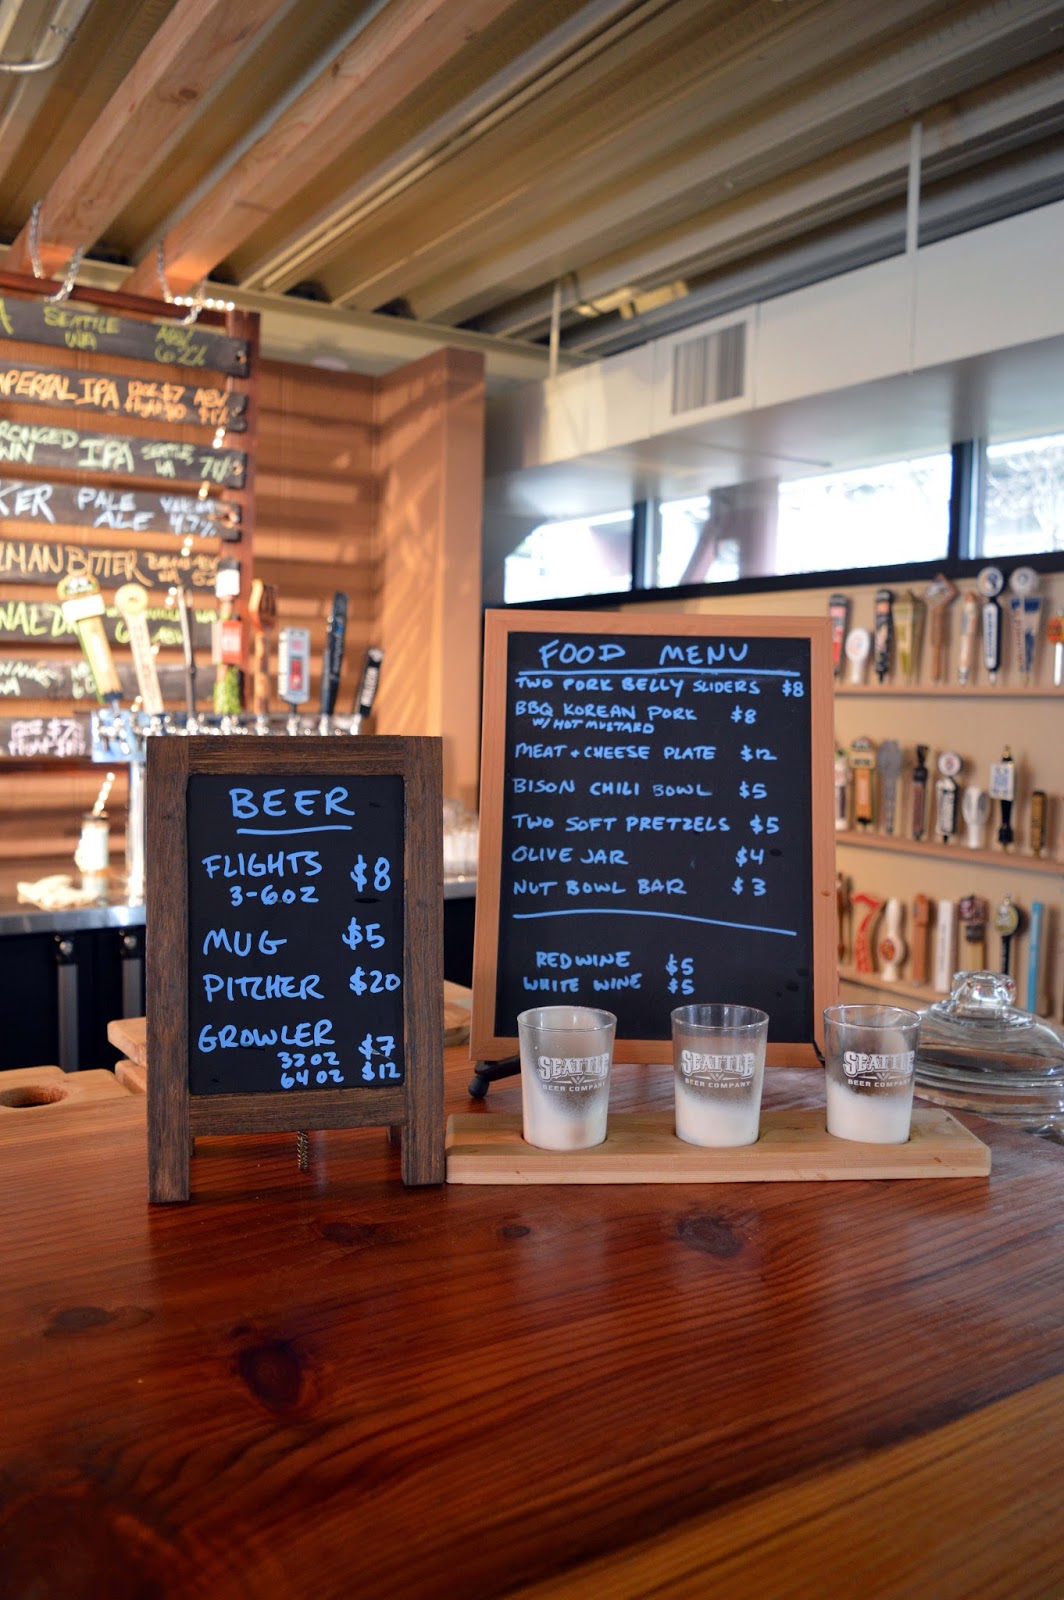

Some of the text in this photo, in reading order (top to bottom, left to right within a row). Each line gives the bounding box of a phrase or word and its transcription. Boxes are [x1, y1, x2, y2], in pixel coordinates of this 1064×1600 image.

[75, 378, 120, 410] IPA
[77, 438, 134, 473] IPA
[78, 486, 136, 512] PALE
[94, 511, 155, 532] ALE
[538, 639, 749, 668] FOOD MENU
[514, 675, 805, 699] TWO PORK BELLY SLIDERS $8
[514, 699, 758, 725] BBQ KOREAN PORK $8
[514, 742, 568, 759] MEAT
[583, 744, 651, 760] CHEESE
[663, 745, 717, 761] PLATE
[739, 744, 778, 763] $12
[513, 777, 768, 800] BISON CHILI BOWL $5
[228, 786, 356, 820] BEER
[511, 813, 780, 835] TWO SOFT PRETZELS $5
[511, 845, 765, 868] OLIVE JAR $4
[201, 850, 392, 893] FLIGHTS $8
[513, 879, 558, 896] NUT
[565, 879, 626, 896] BOWL
[636, 877, 687, 895] BAR
[202, 916, 386, 957] MUG $5
[665, 953, 695, 977] $5
[202, 965, 401, 1003] PITCHER $20
[522, 972, 695, 996] WHITE WINE $5
[197, 1018, 337, 1053] GROWLER
[357, 1032, 396, 1061] $7
[361, 1060, 401, 1082] $12
[537, 1052, 610, 1082] SEATTLE
[681, 1049, 755, 1079] SEATTLE
[843, 1050, 915, 1077] SEATTLE
[684, 1077, 705, 1088] BEER
[848, 1079, 872, 1088] BEER
